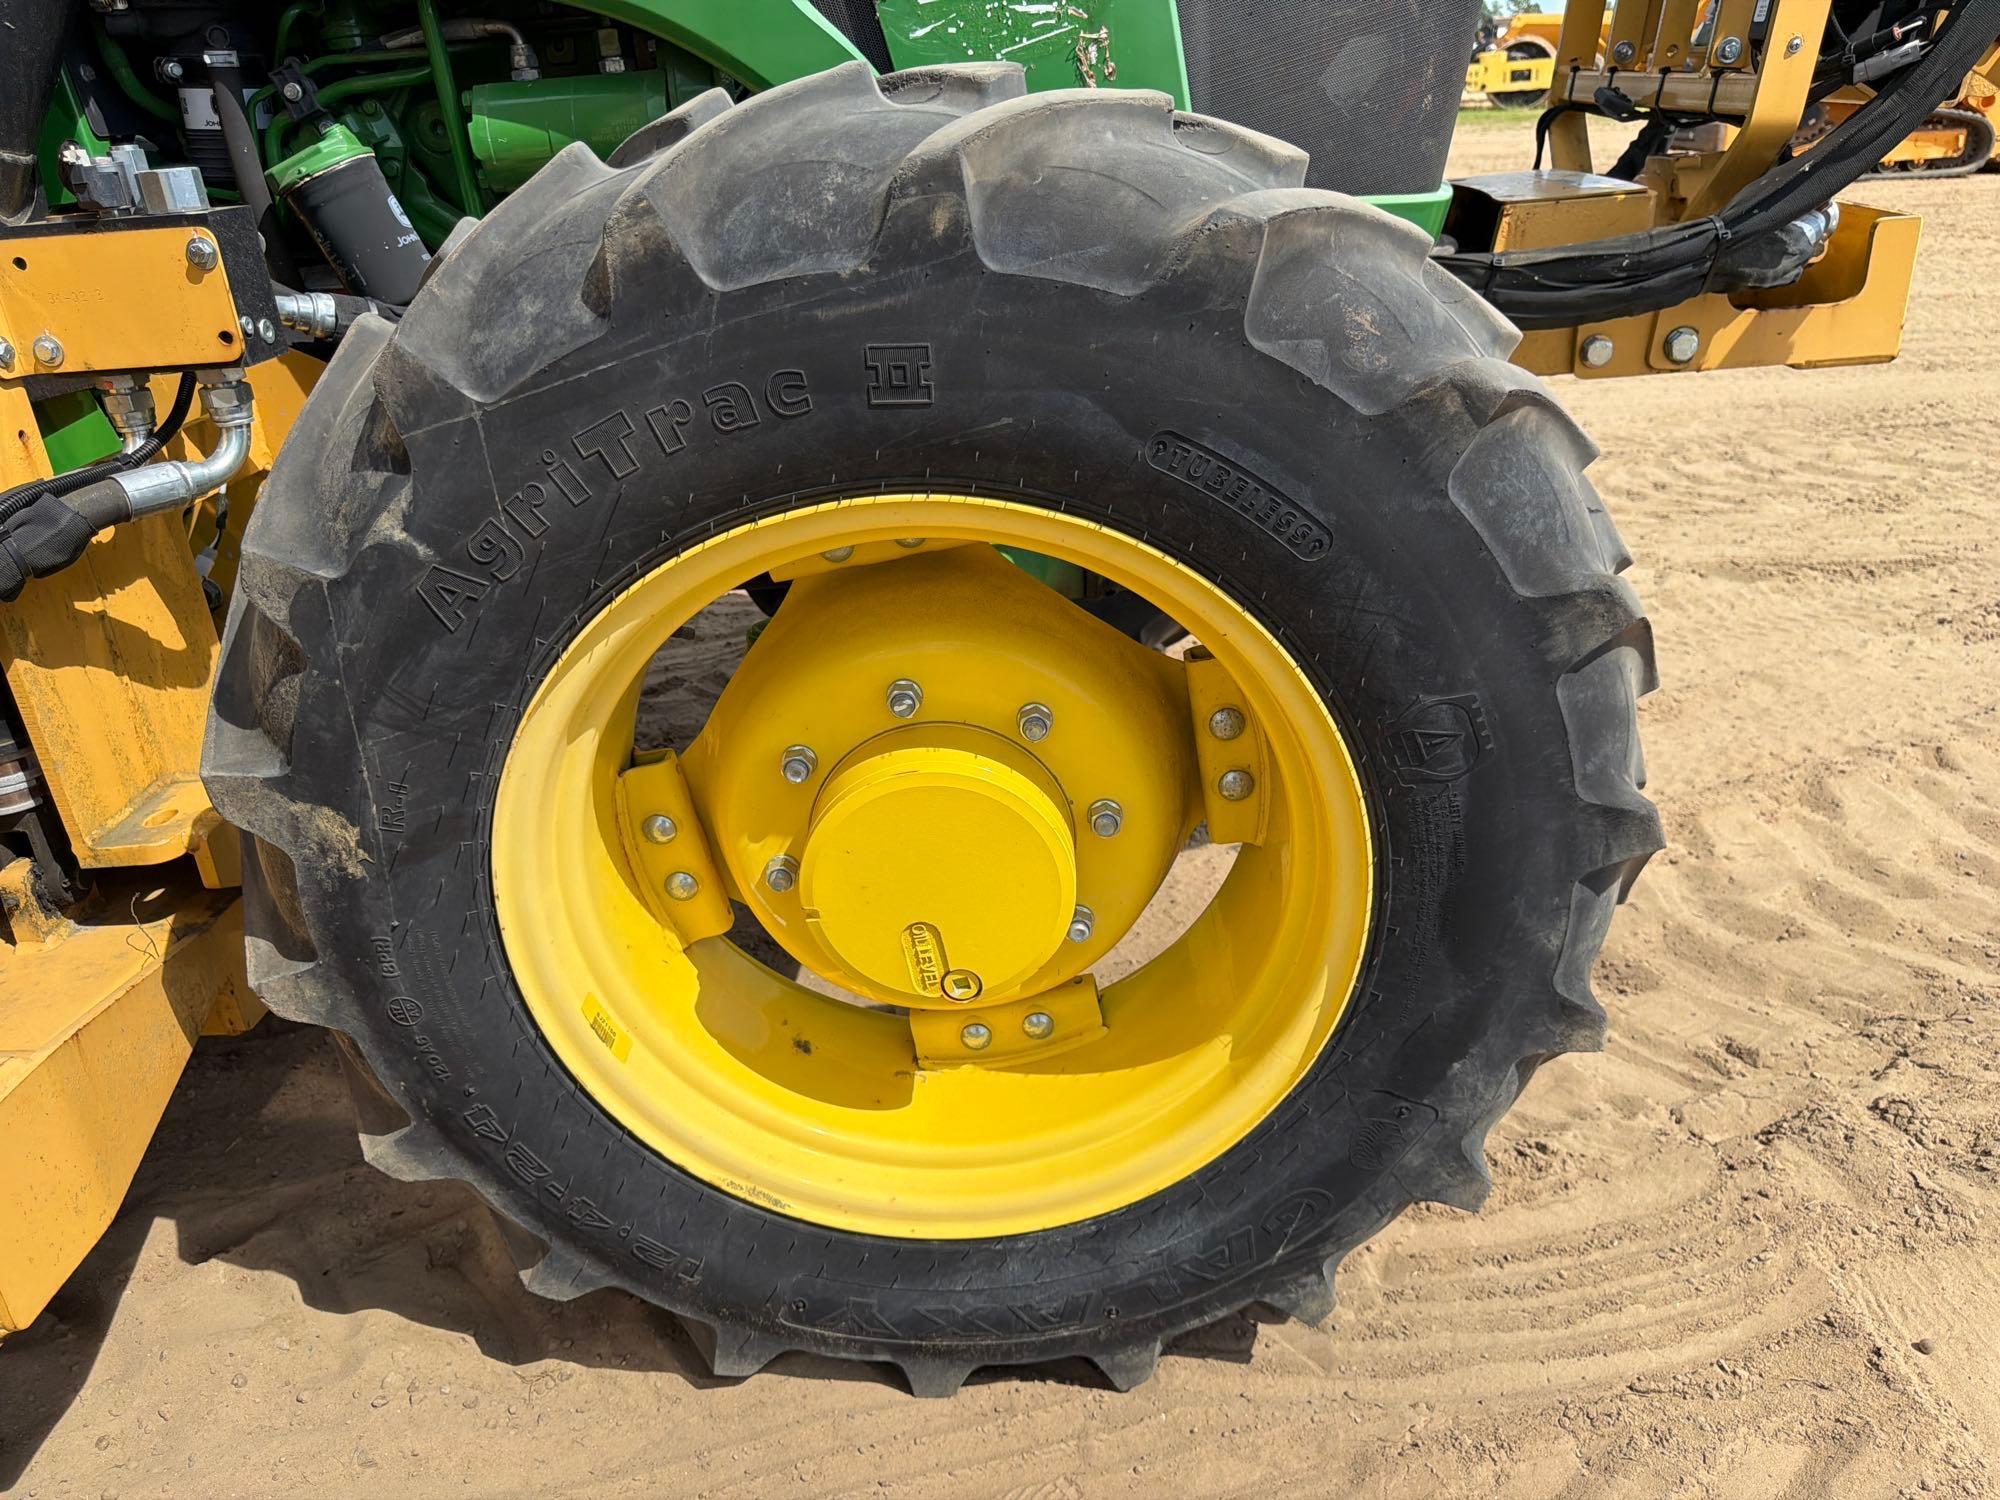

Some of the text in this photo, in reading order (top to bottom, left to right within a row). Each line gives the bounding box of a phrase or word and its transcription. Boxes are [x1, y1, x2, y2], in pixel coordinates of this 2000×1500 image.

[204, 119, 221, 127] JOH
[416, 368, 814, 634] AgriTrac
[1166, 443, 1315, 548] TUBELESS
[379, 782, 409, 833] R-1
[371, 936, 401, 979] (8PR)
[912, 924, 939, 992] OIL LEVEL
[463, 1103, 706, 1287] 12.4-24
